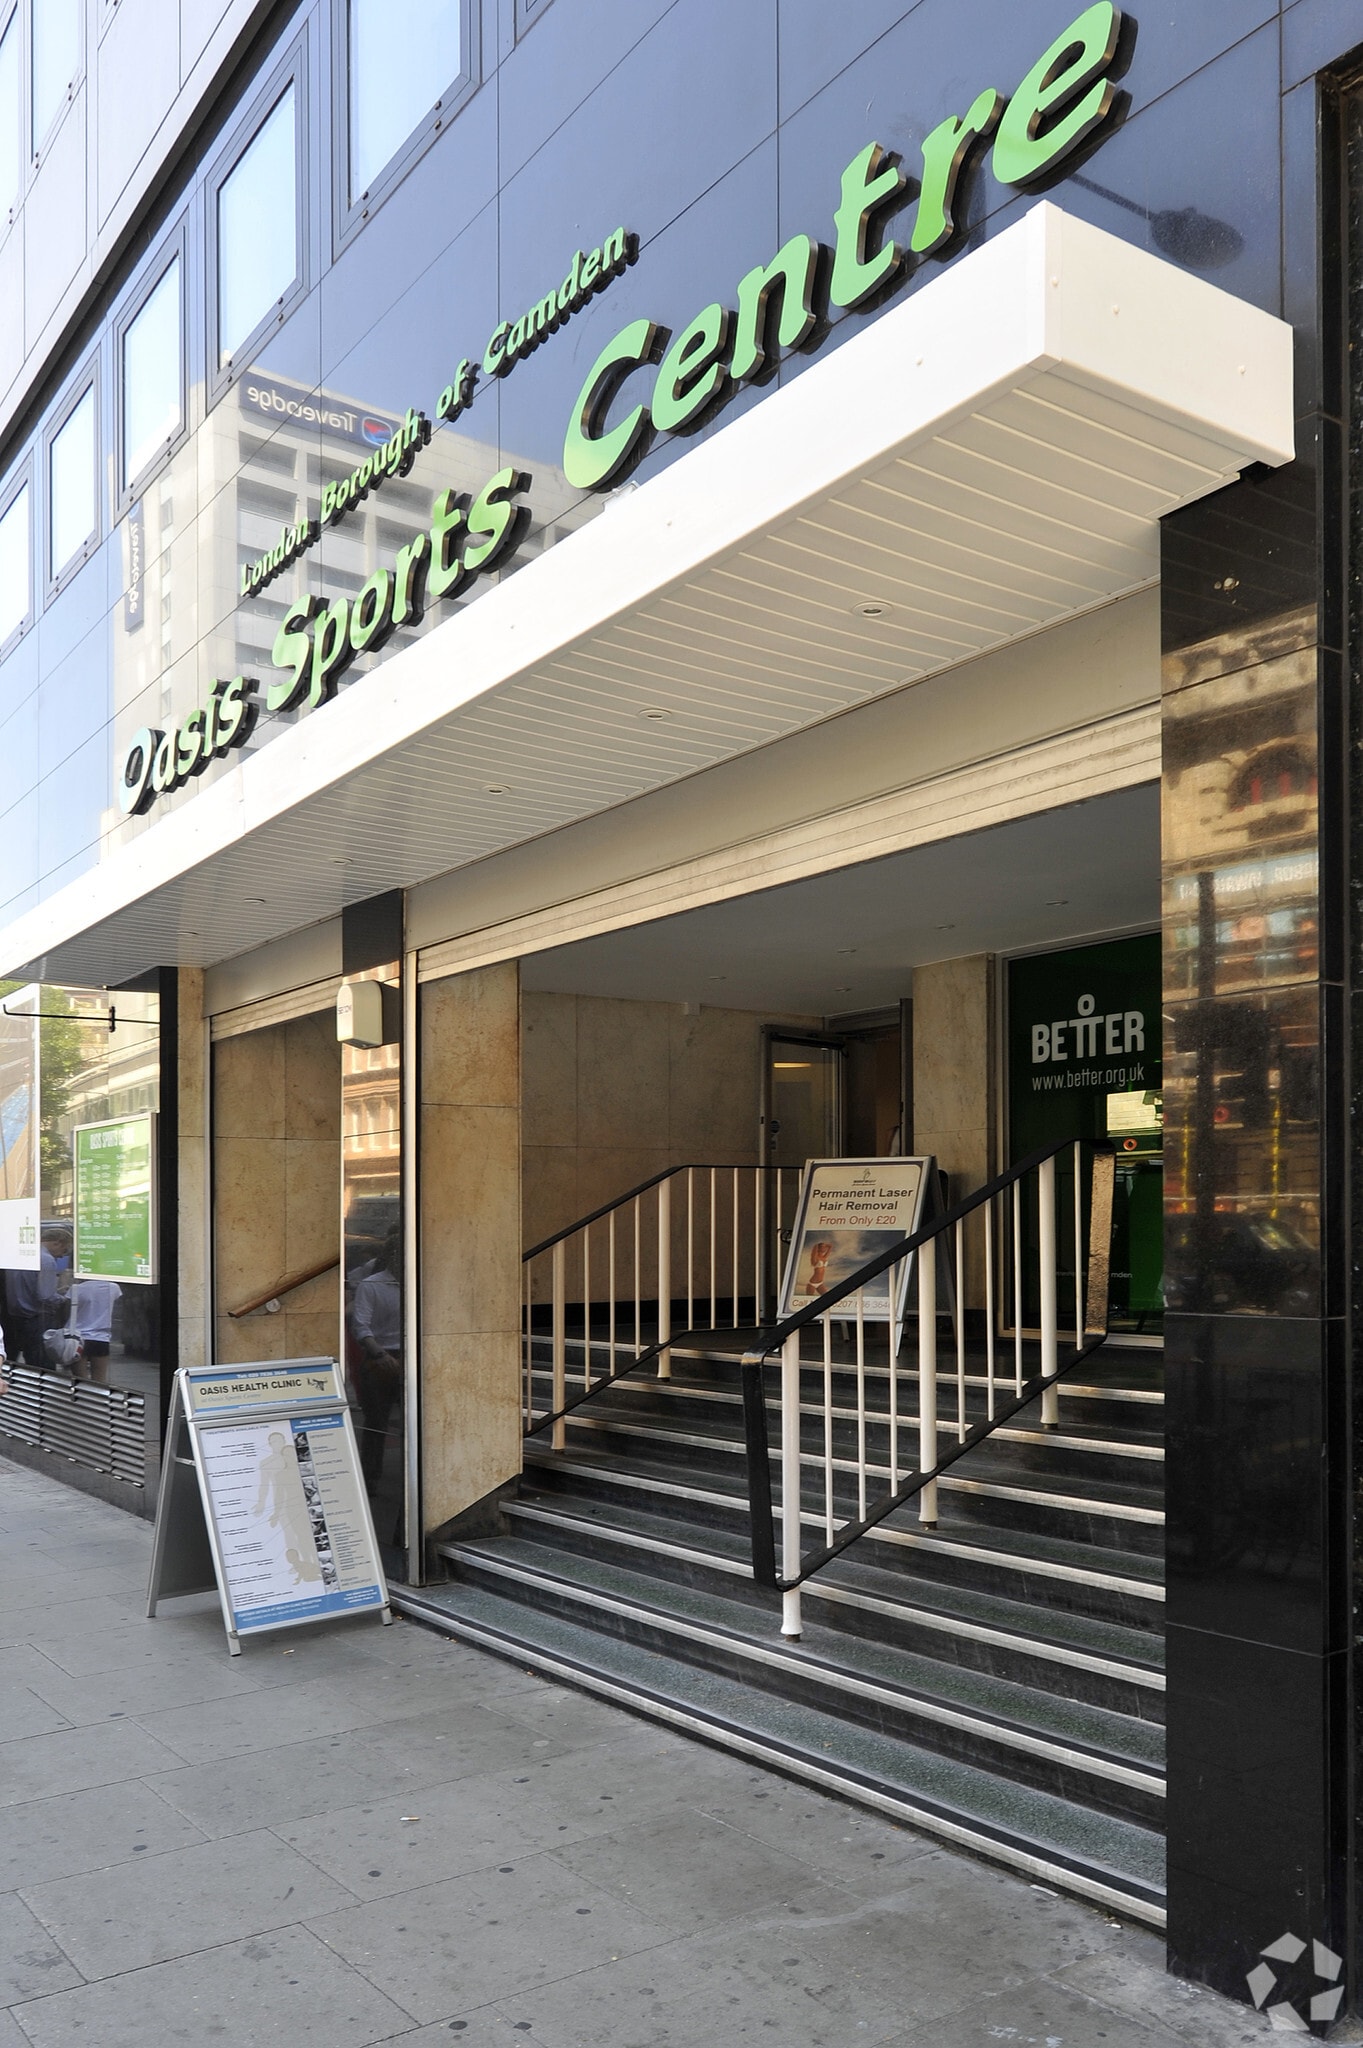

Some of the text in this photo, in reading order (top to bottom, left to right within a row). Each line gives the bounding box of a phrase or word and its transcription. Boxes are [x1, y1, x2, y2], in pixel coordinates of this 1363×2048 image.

[119, 0, 1130, 815] Oasis Sports Centre
[240, 227, 636, 598] London Borough of Camden
[1032, 1010, 1145, 1063] BETTER
[1032, 1063, 1145, 1091] www.better.org.uk
[812, 1188, 914, 1198] Permanent Laser
[819, 1201, 898, 1210] Hair Removal
[819, 1215, 897, 1227] From Only £20
[200, 1379, 302, 1395] OASIS HEALTH CLINIC
